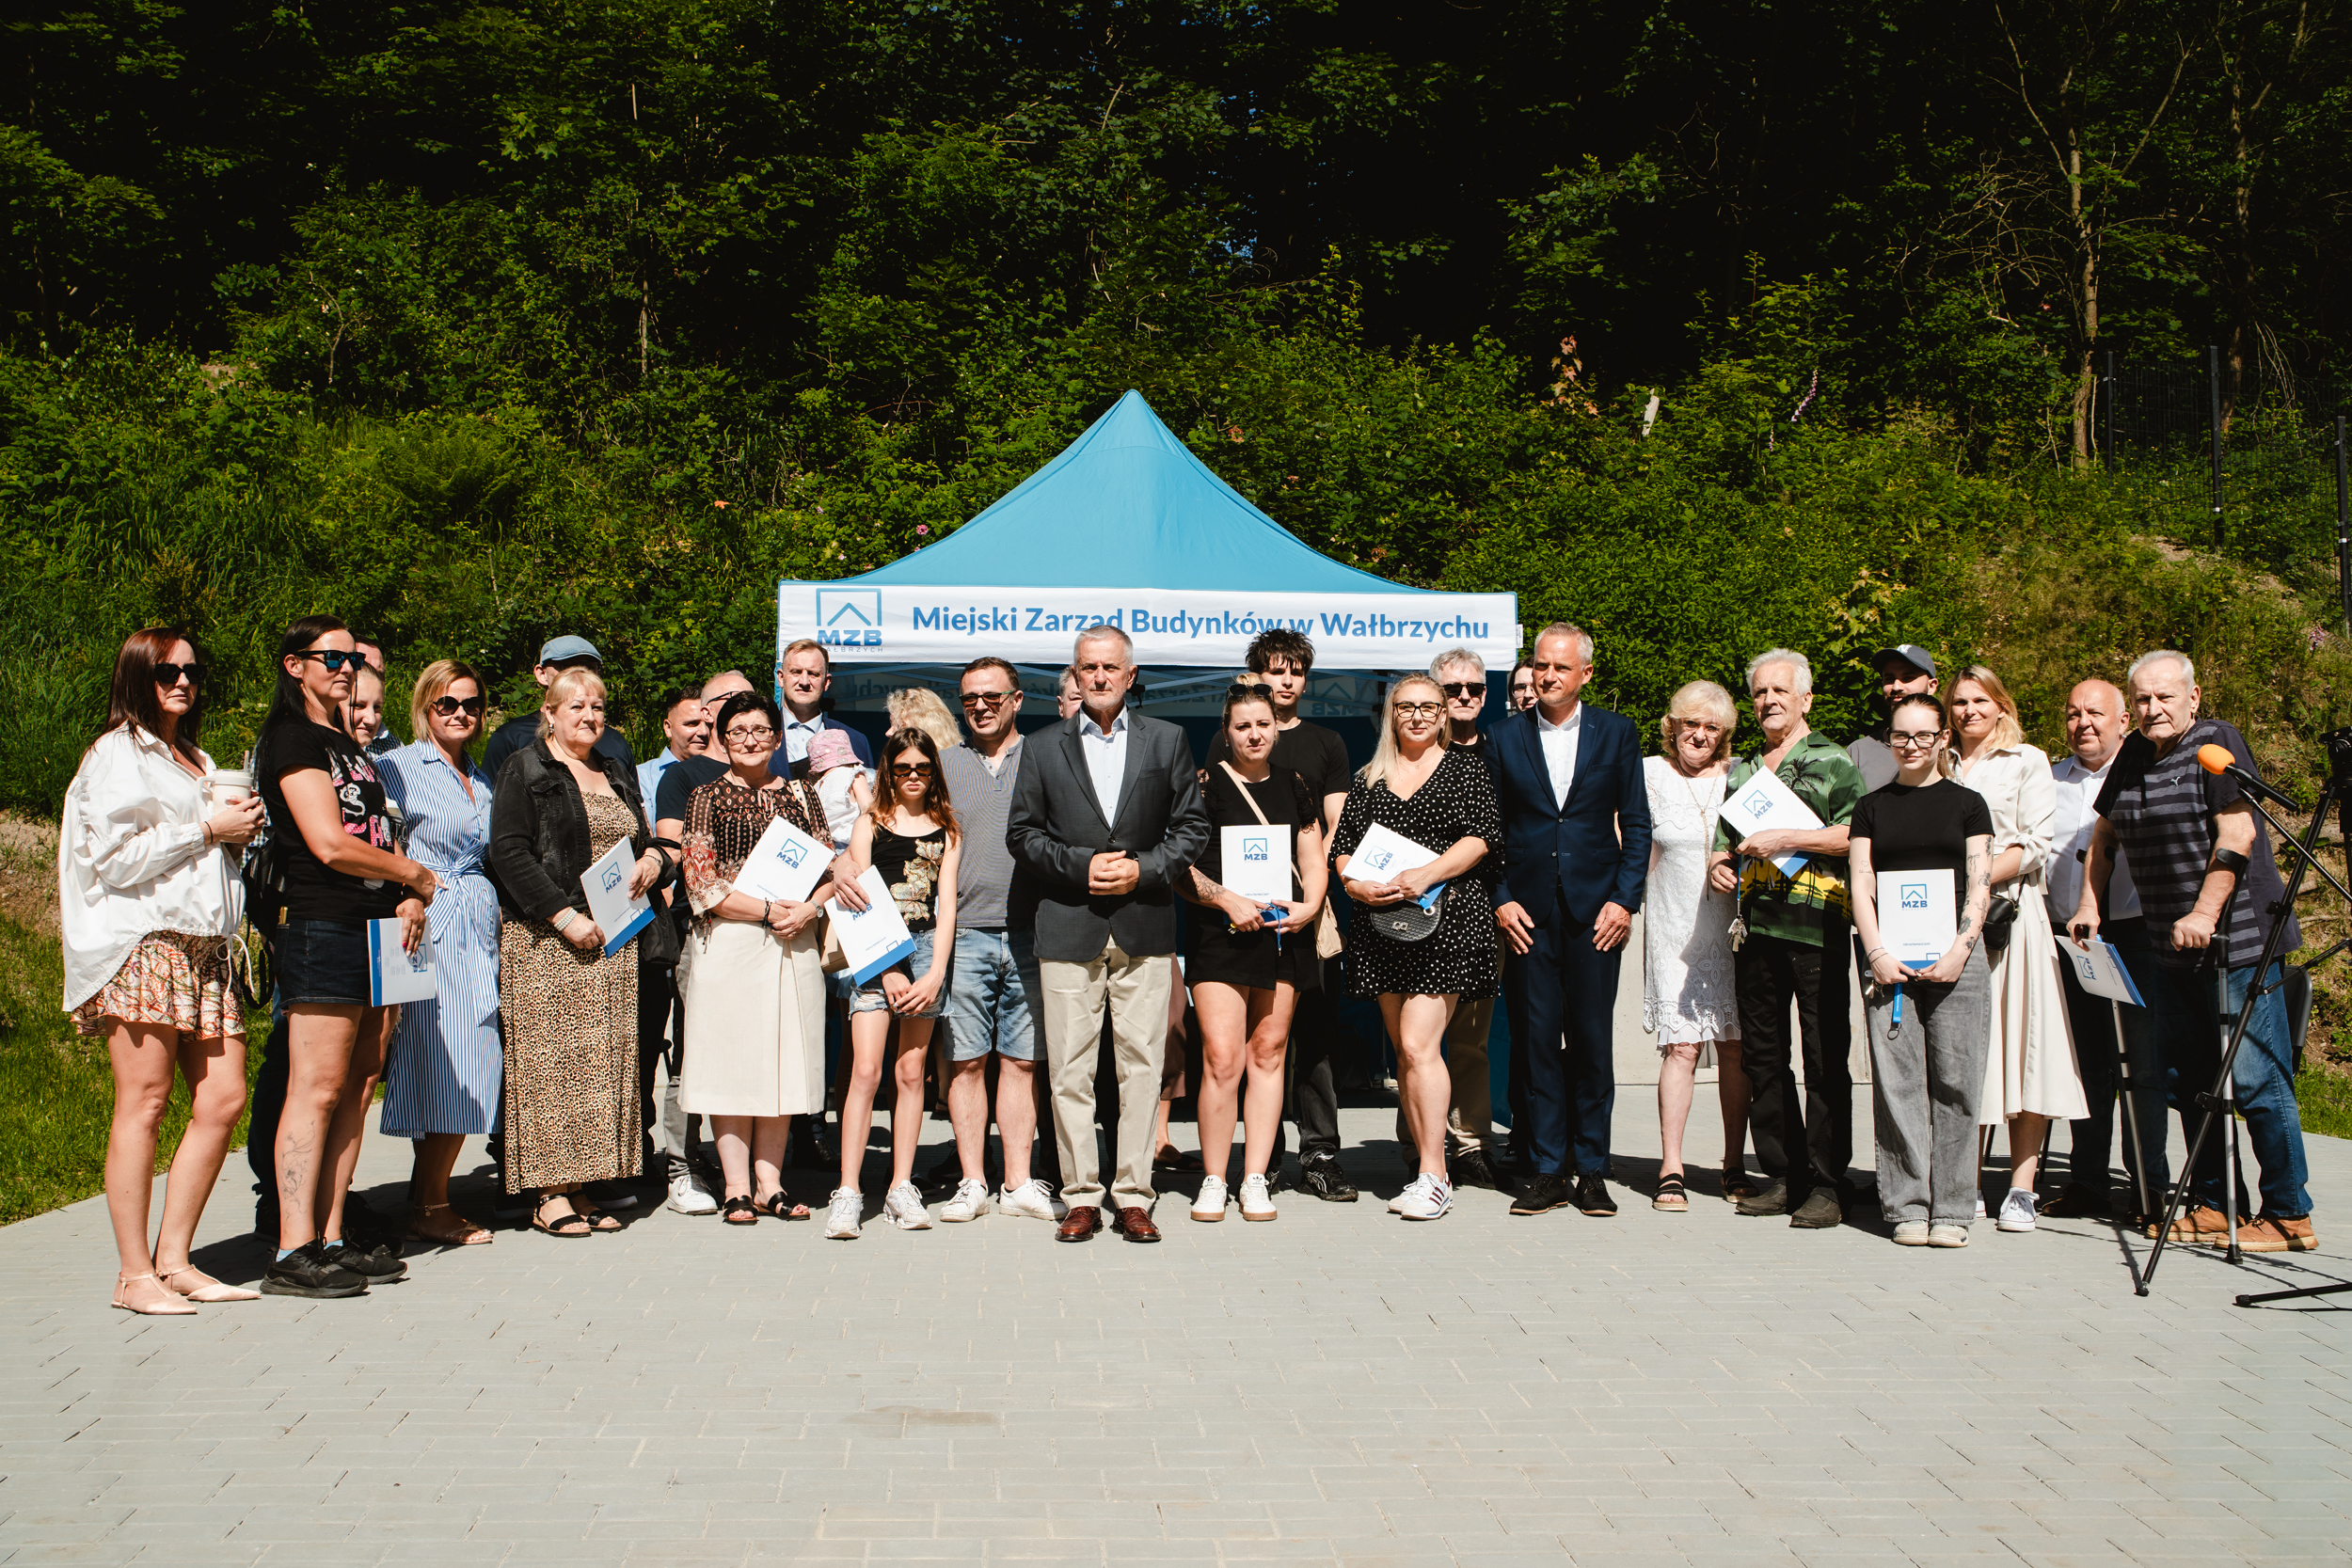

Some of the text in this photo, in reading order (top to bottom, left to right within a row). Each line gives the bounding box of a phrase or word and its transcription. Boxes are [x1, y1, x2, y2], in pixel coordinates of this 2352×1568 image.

[913, 606, 1017, 636] Miejski
[1131, 609, 1282, 639] Budynków
[1288, 618, 1314, 636] w
[1319, 612, 1489, 643] Wałbrzychu
[816, 629, 882, 646] MZB
[1754, 800, 1773, 819] MZB
[776, 851, 800, 869] MZB
[1377, 851, 1393, 870] MZB
[605, 875, 622, 894] MZB
[1901, 900, 1928, 909] MZB
